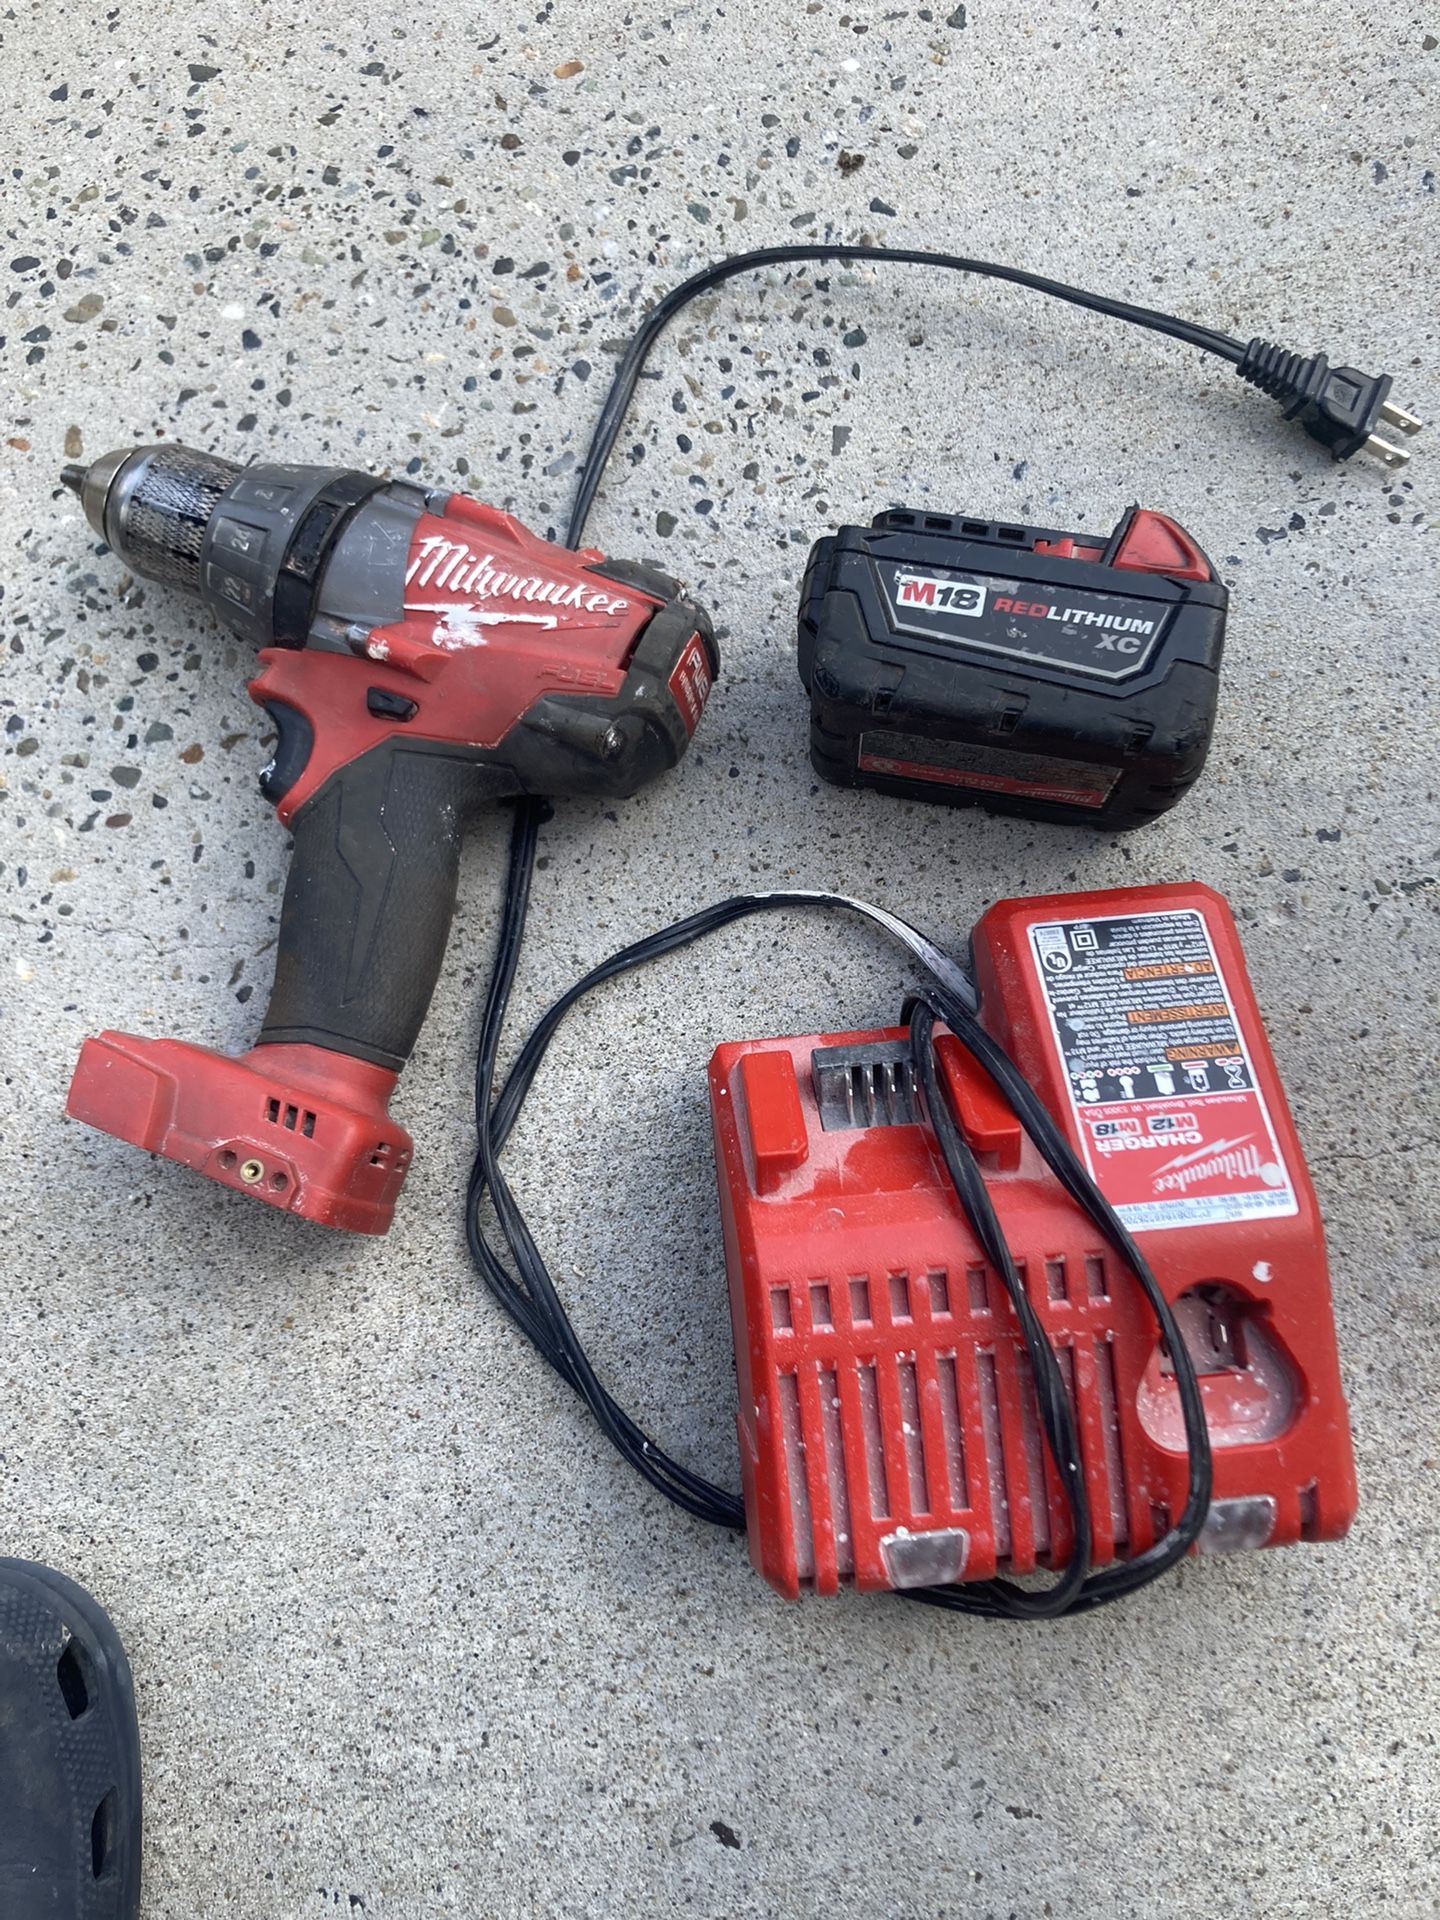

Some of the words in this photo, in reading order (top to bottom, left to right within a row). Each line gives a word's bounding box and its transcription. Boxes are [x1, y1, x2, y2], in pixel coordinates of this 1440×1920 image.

[405, 535, 628, 616] Milwaukee
[223, 577, 241, 600] 22
[903, 580, 980, 611] M18
[993, 598, 1154, 635] REDLITHIUM
[1095, 632, 1142, 654] XC
[537, 663, 616, 690] FUEL
[1129, 1003, 1225, 1021] AVERTISSEMENT
[1166, 1044, 1226, 1059] WARNING
[1093, 1121, 1137, 1136] M18
[1150, 1116, 1194, 1130] M12
[1093, 1131, 1204, 1152] CHARGER
[1154, 1144, 1263, 1193] Milwaukee
